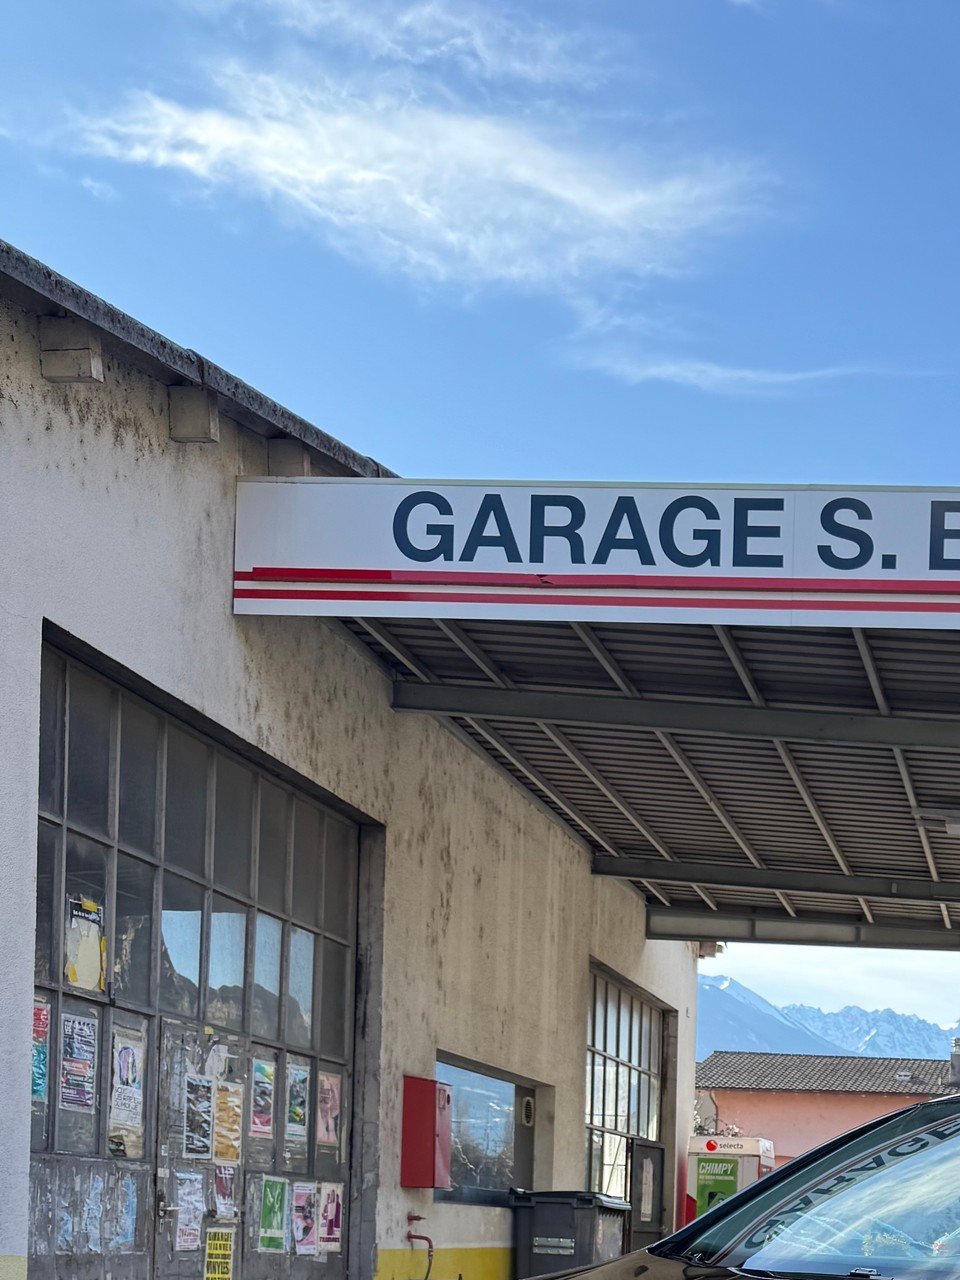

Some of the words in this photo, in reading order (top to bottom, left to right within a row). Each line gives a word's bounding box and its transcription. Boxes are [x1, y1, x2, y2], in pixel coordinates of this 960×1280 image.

[392, 491, 785, 569] GARAGE
[816, 497, 897, 570] S.
[699, 1162, 734, 1175] CHIMPY
